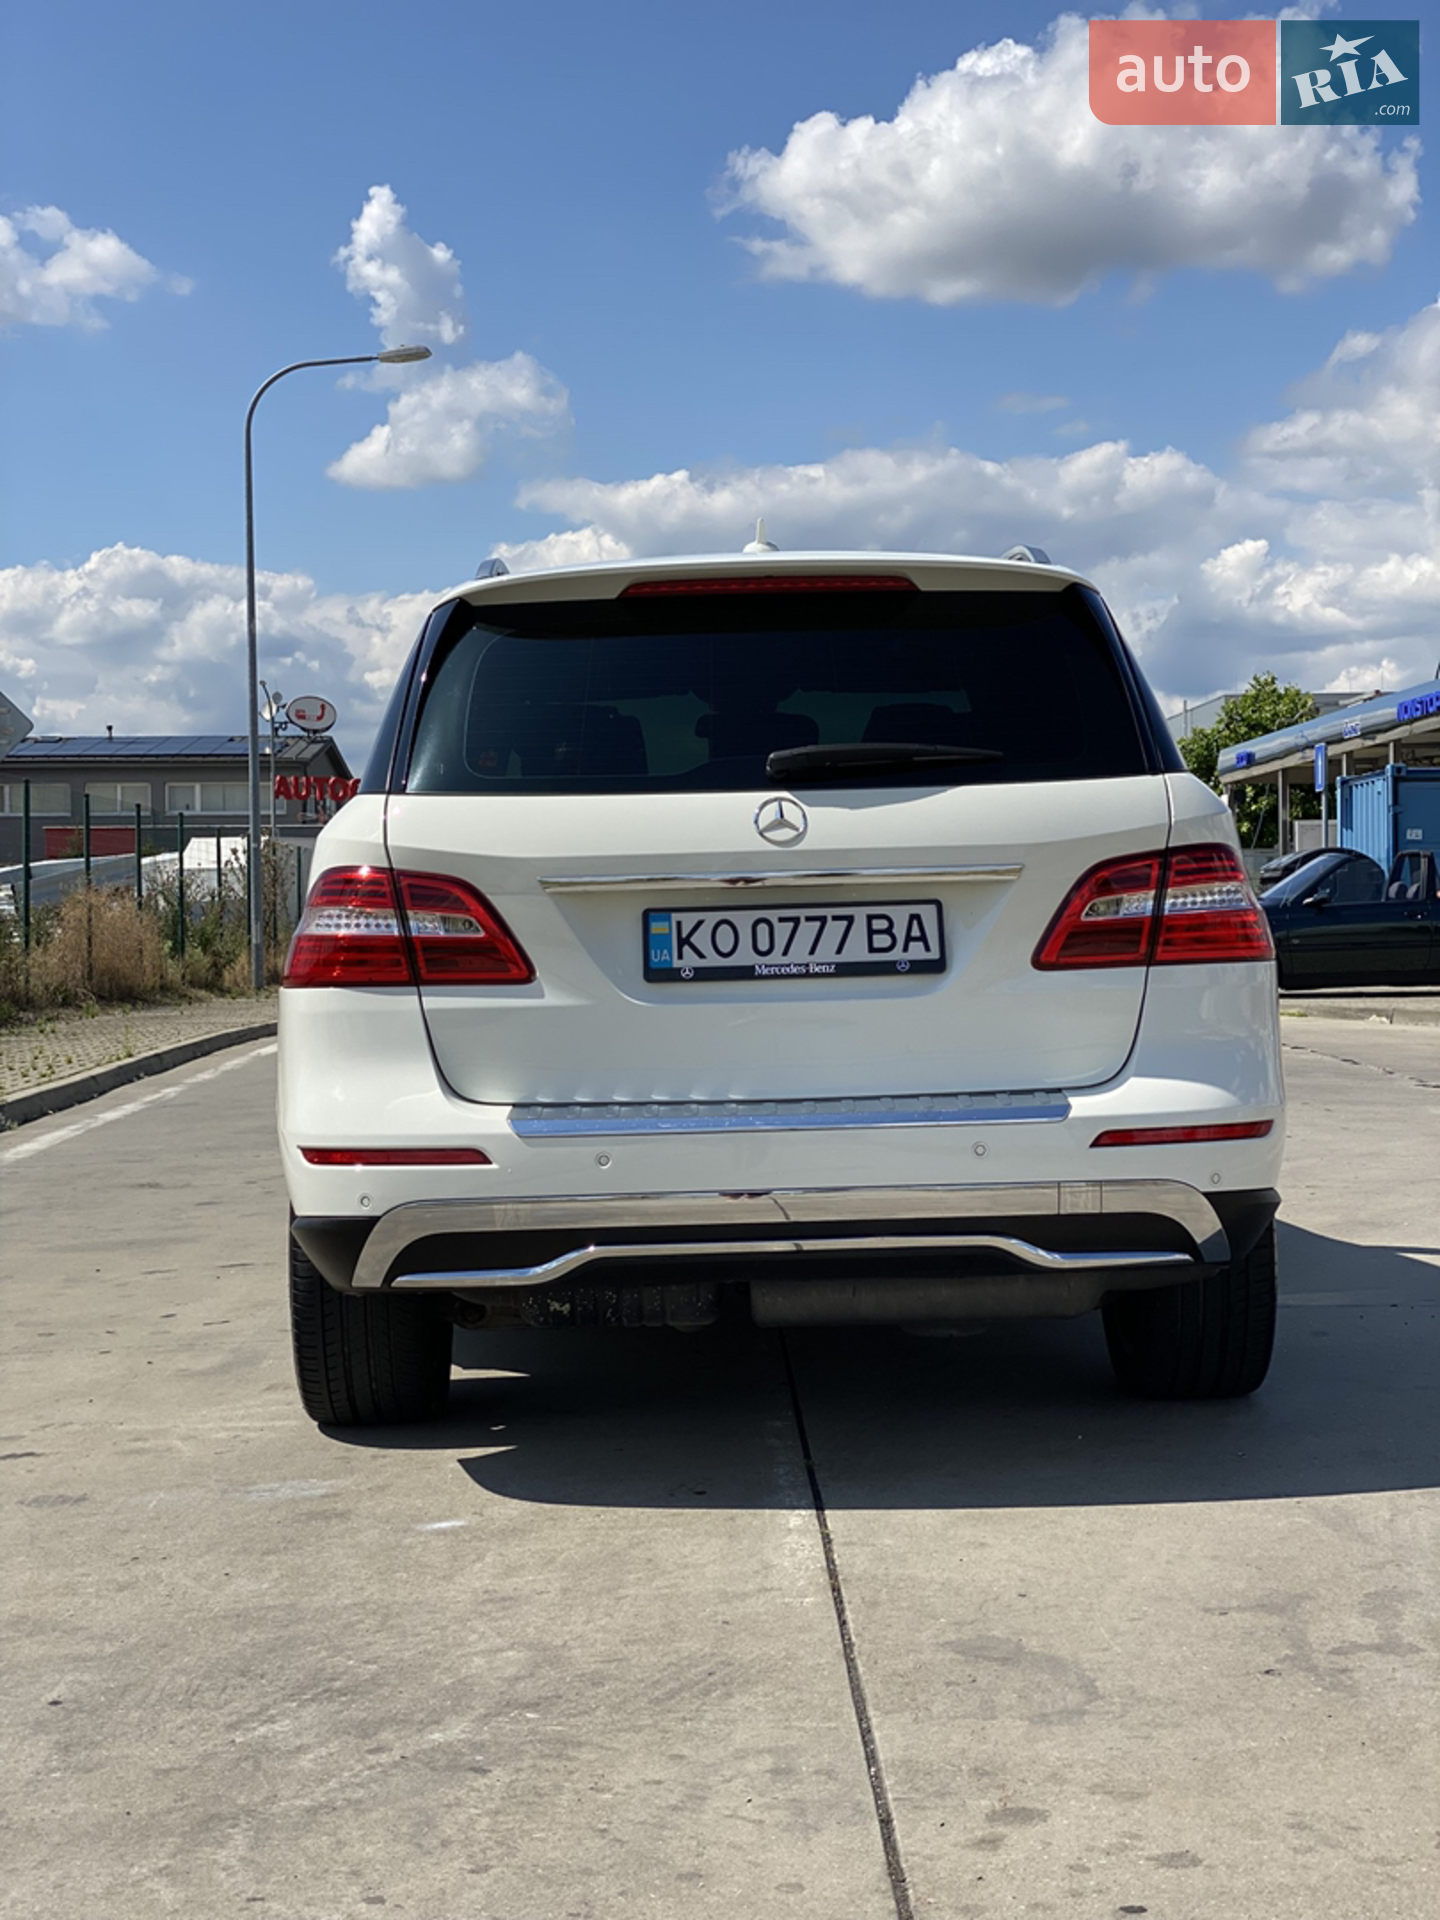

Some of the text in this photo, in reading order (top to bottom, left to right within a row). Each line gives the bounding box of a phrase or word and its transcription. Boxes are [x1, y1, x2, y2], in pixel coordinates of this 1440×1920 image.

[676, 913, 932, 961] KO 0777 BA
[651, 949, 671, 962] UA
